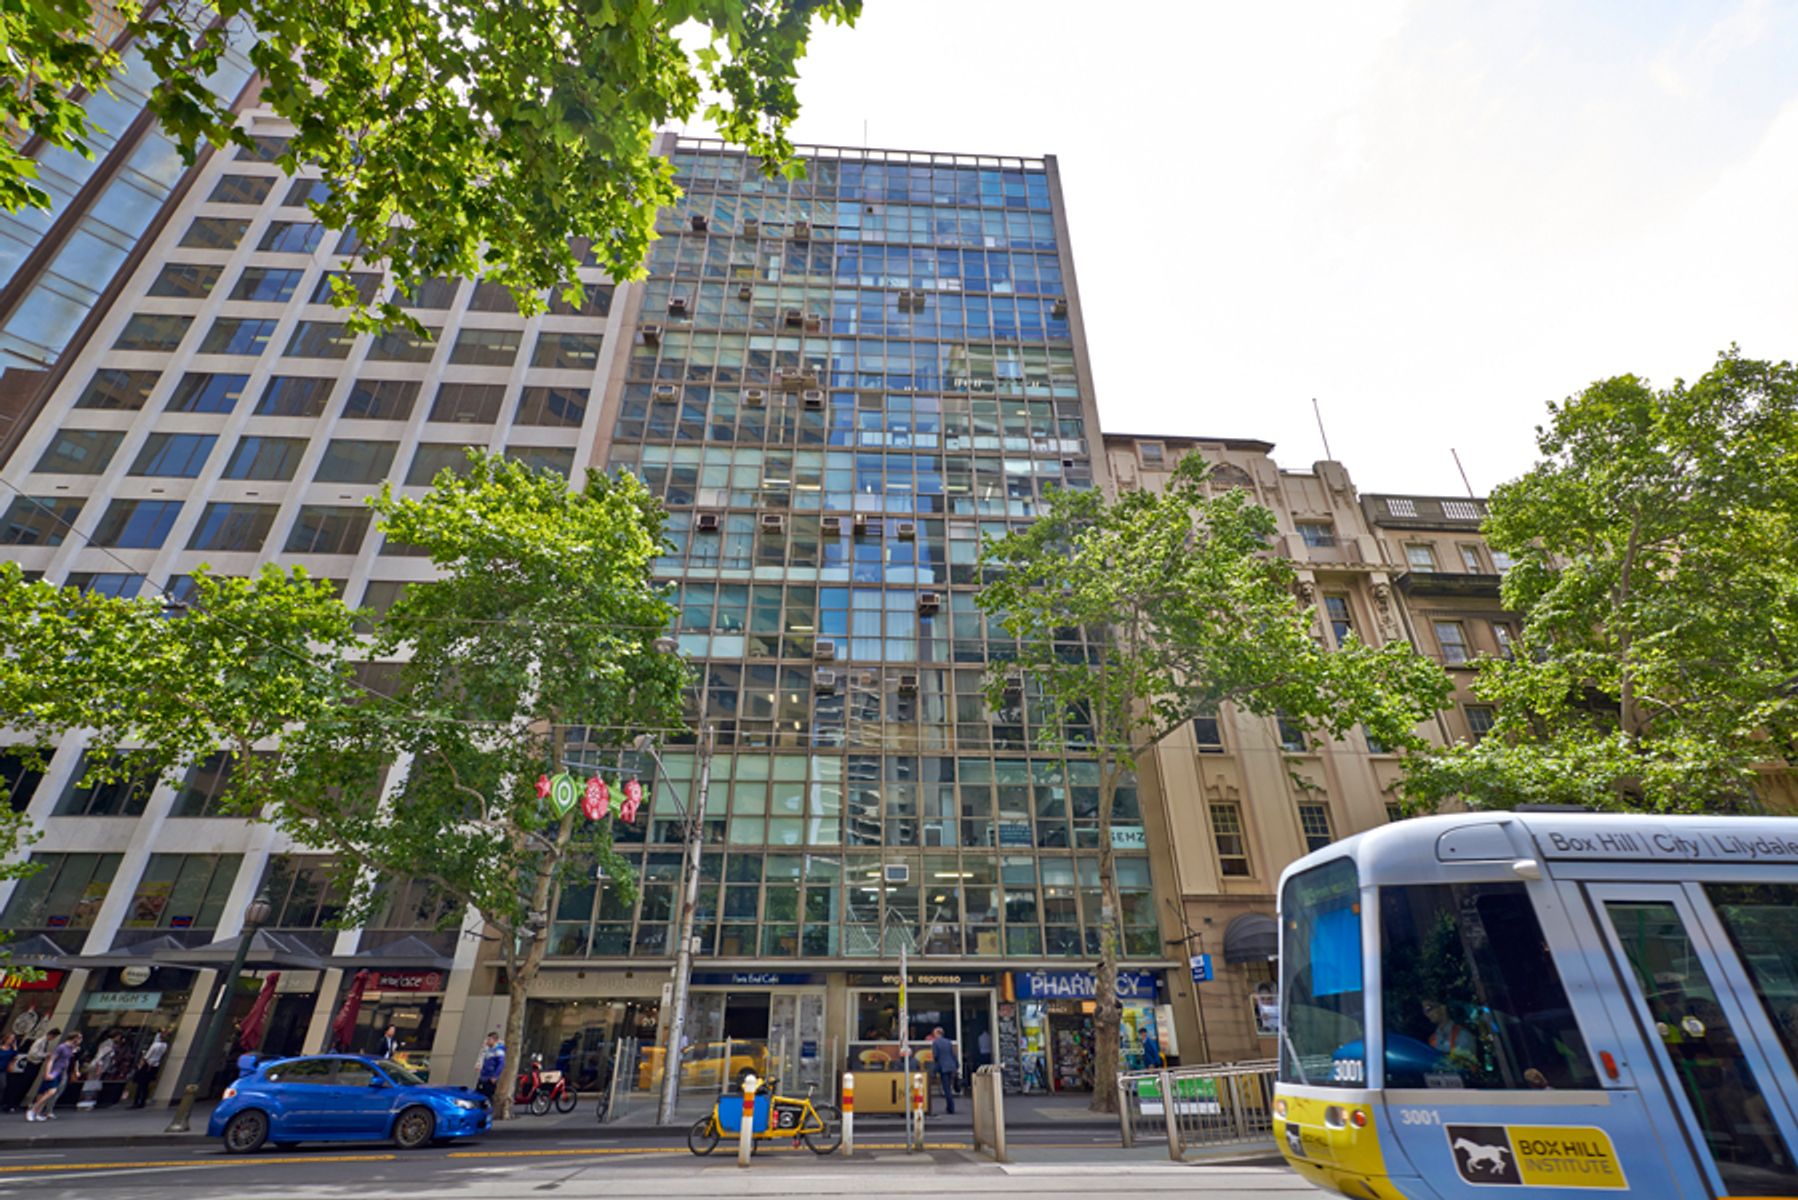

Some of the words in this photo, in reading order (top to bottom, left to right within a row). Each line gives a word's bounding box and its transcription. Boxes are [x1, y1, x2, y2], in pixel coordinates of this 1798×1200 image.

[1549, 832, 1597, 851] Box
[1596, 833, 1640, 851] Hill
[1653, 834, 1699, 857] City
[1712, 835, 1798, 859] Lilydale
[918, 975, 961, 984] espresso
[1031, 976, 1140, 996] PHARMCY
[100, 993, 149, 1003] HAIGH'S
[1333, 1060, 1364, 1082] 3001
[1400, 1110, 1441, 1125] 3001
[1518, 1140, 1562, 1156] BOX
[1562, 1141, 1608, 1158] HILL
[1524, 1158, 1614, 1174] INSTITUTE
